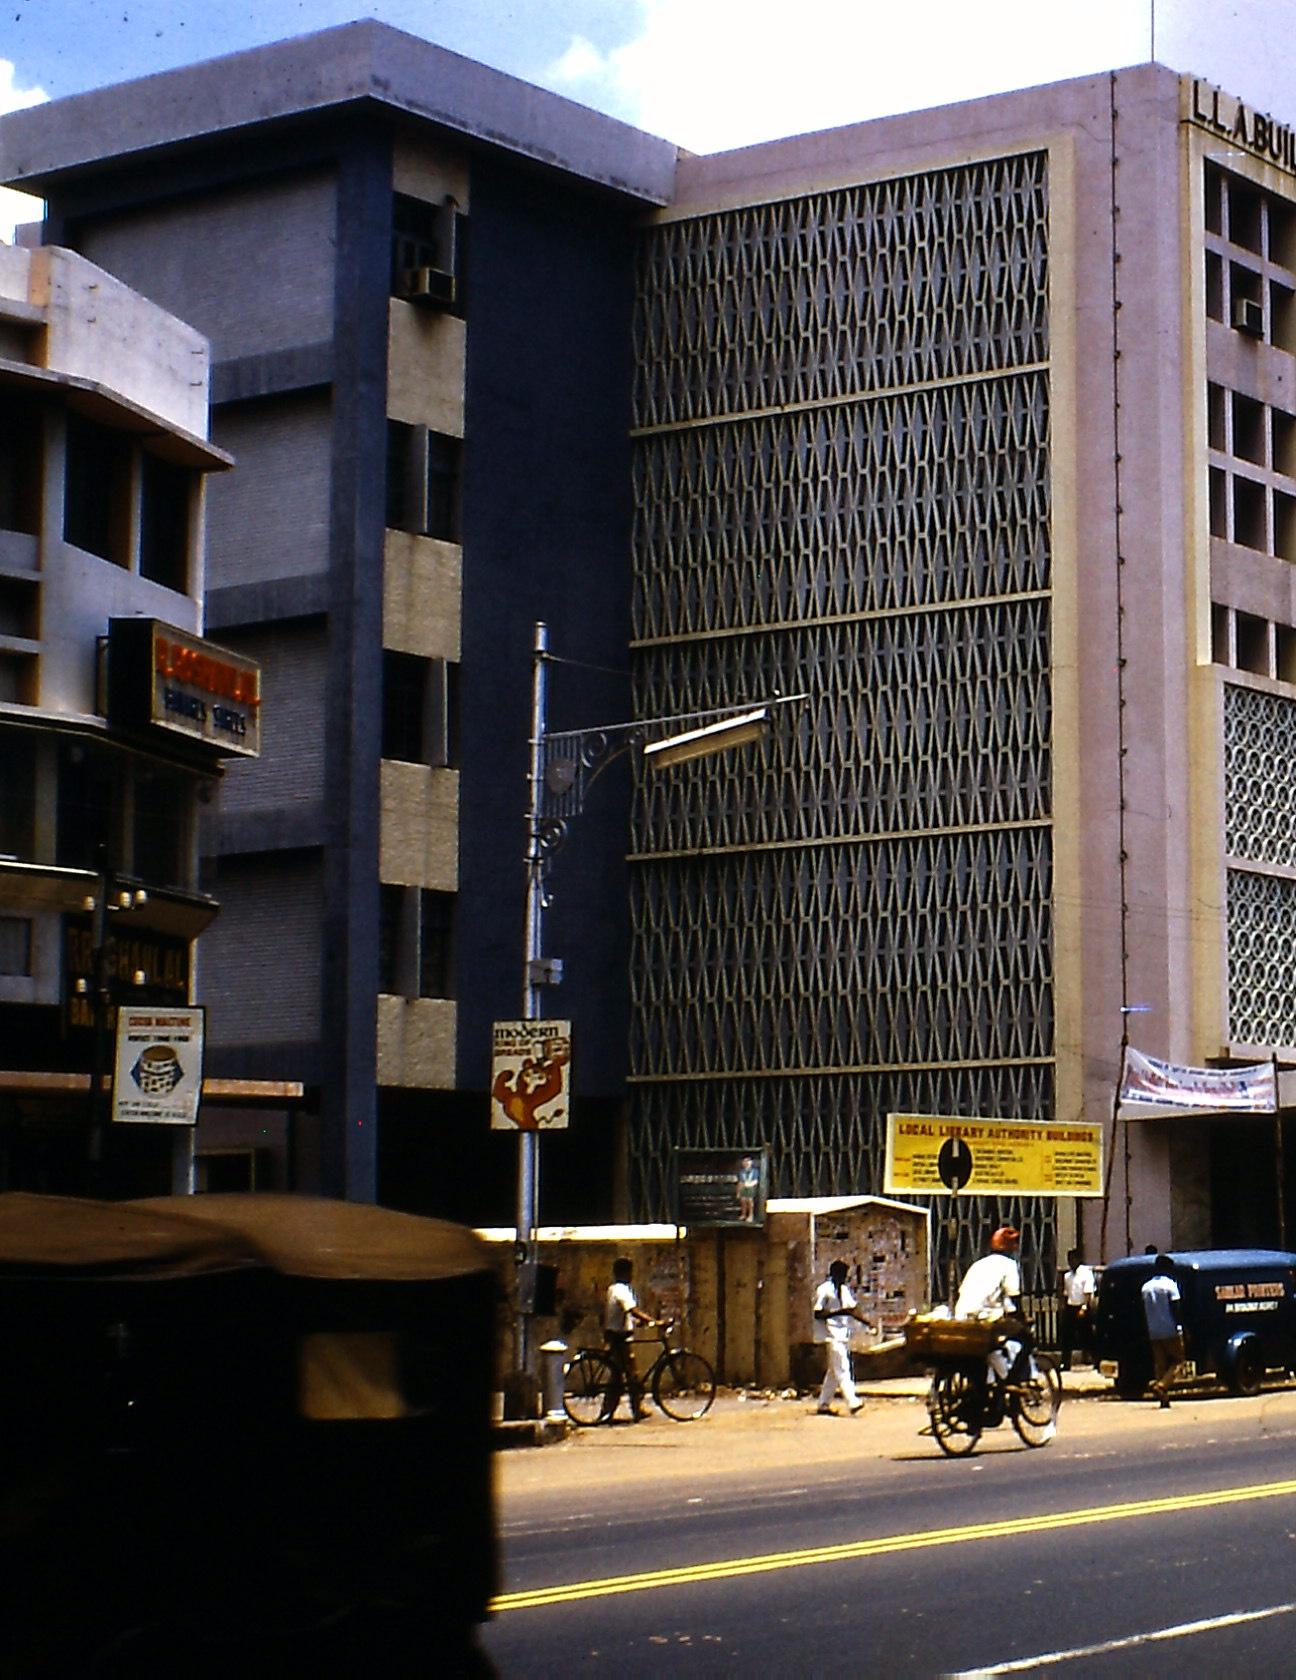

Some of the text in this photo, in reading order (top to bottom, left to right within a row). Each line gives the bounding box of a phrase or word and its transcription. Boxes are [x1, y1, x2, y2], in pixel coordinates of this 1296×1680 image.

[898, 1124, 935, 1137] LOCAL
[939, 1126, 984, 1139] LIBRARY
[986, 1128, 1043, 1142] AUTHORITY
